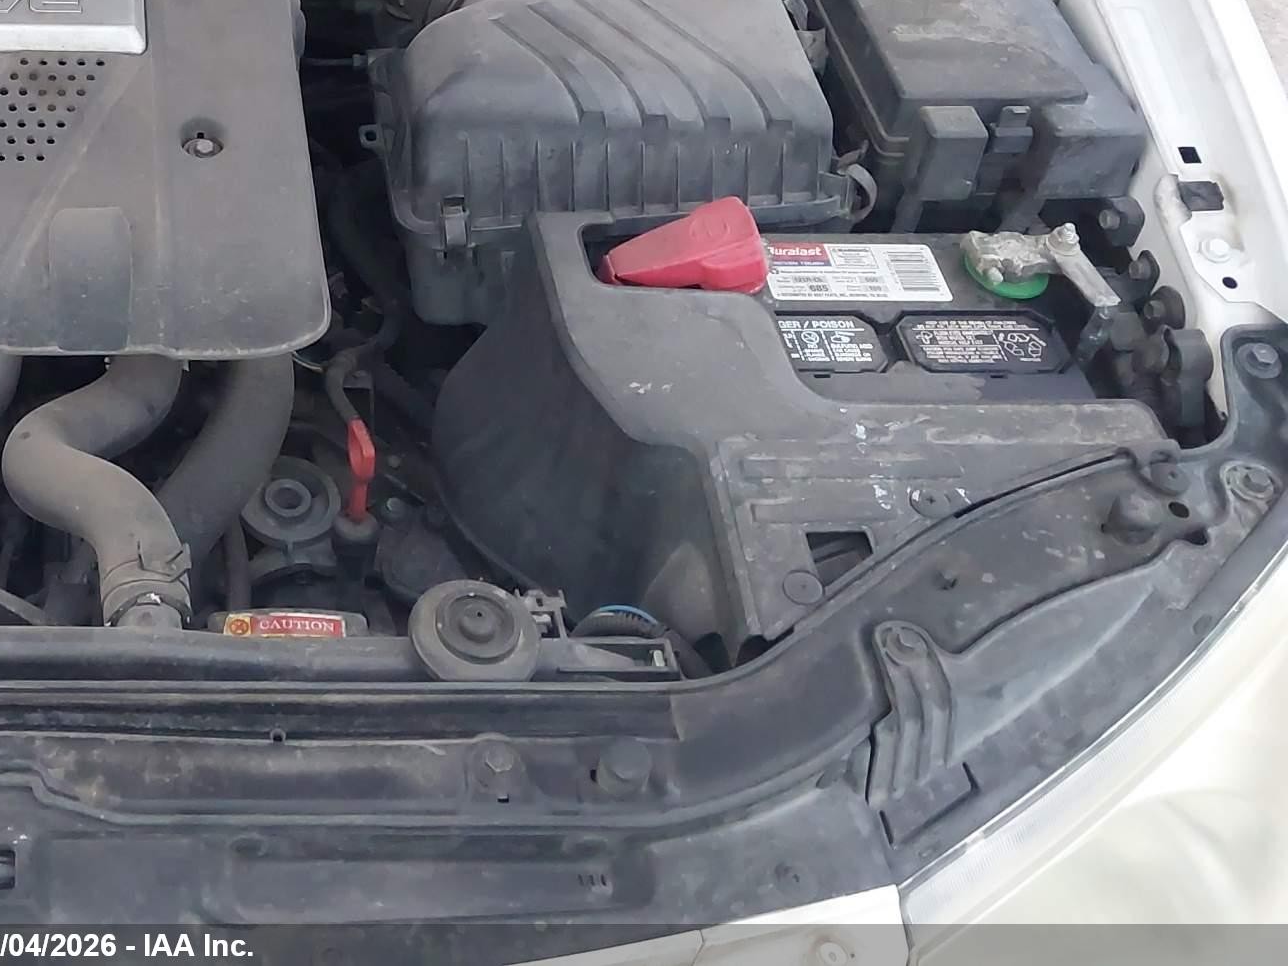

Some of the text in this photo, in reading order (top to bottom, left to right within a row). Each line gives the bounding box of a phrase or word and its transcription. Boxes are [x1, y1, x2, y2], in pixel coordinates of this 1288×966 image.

[778, 320, 801, 329] GER
[811, 320, 855, 329] POISON
[259, 619, 335, 632] CAUTION
